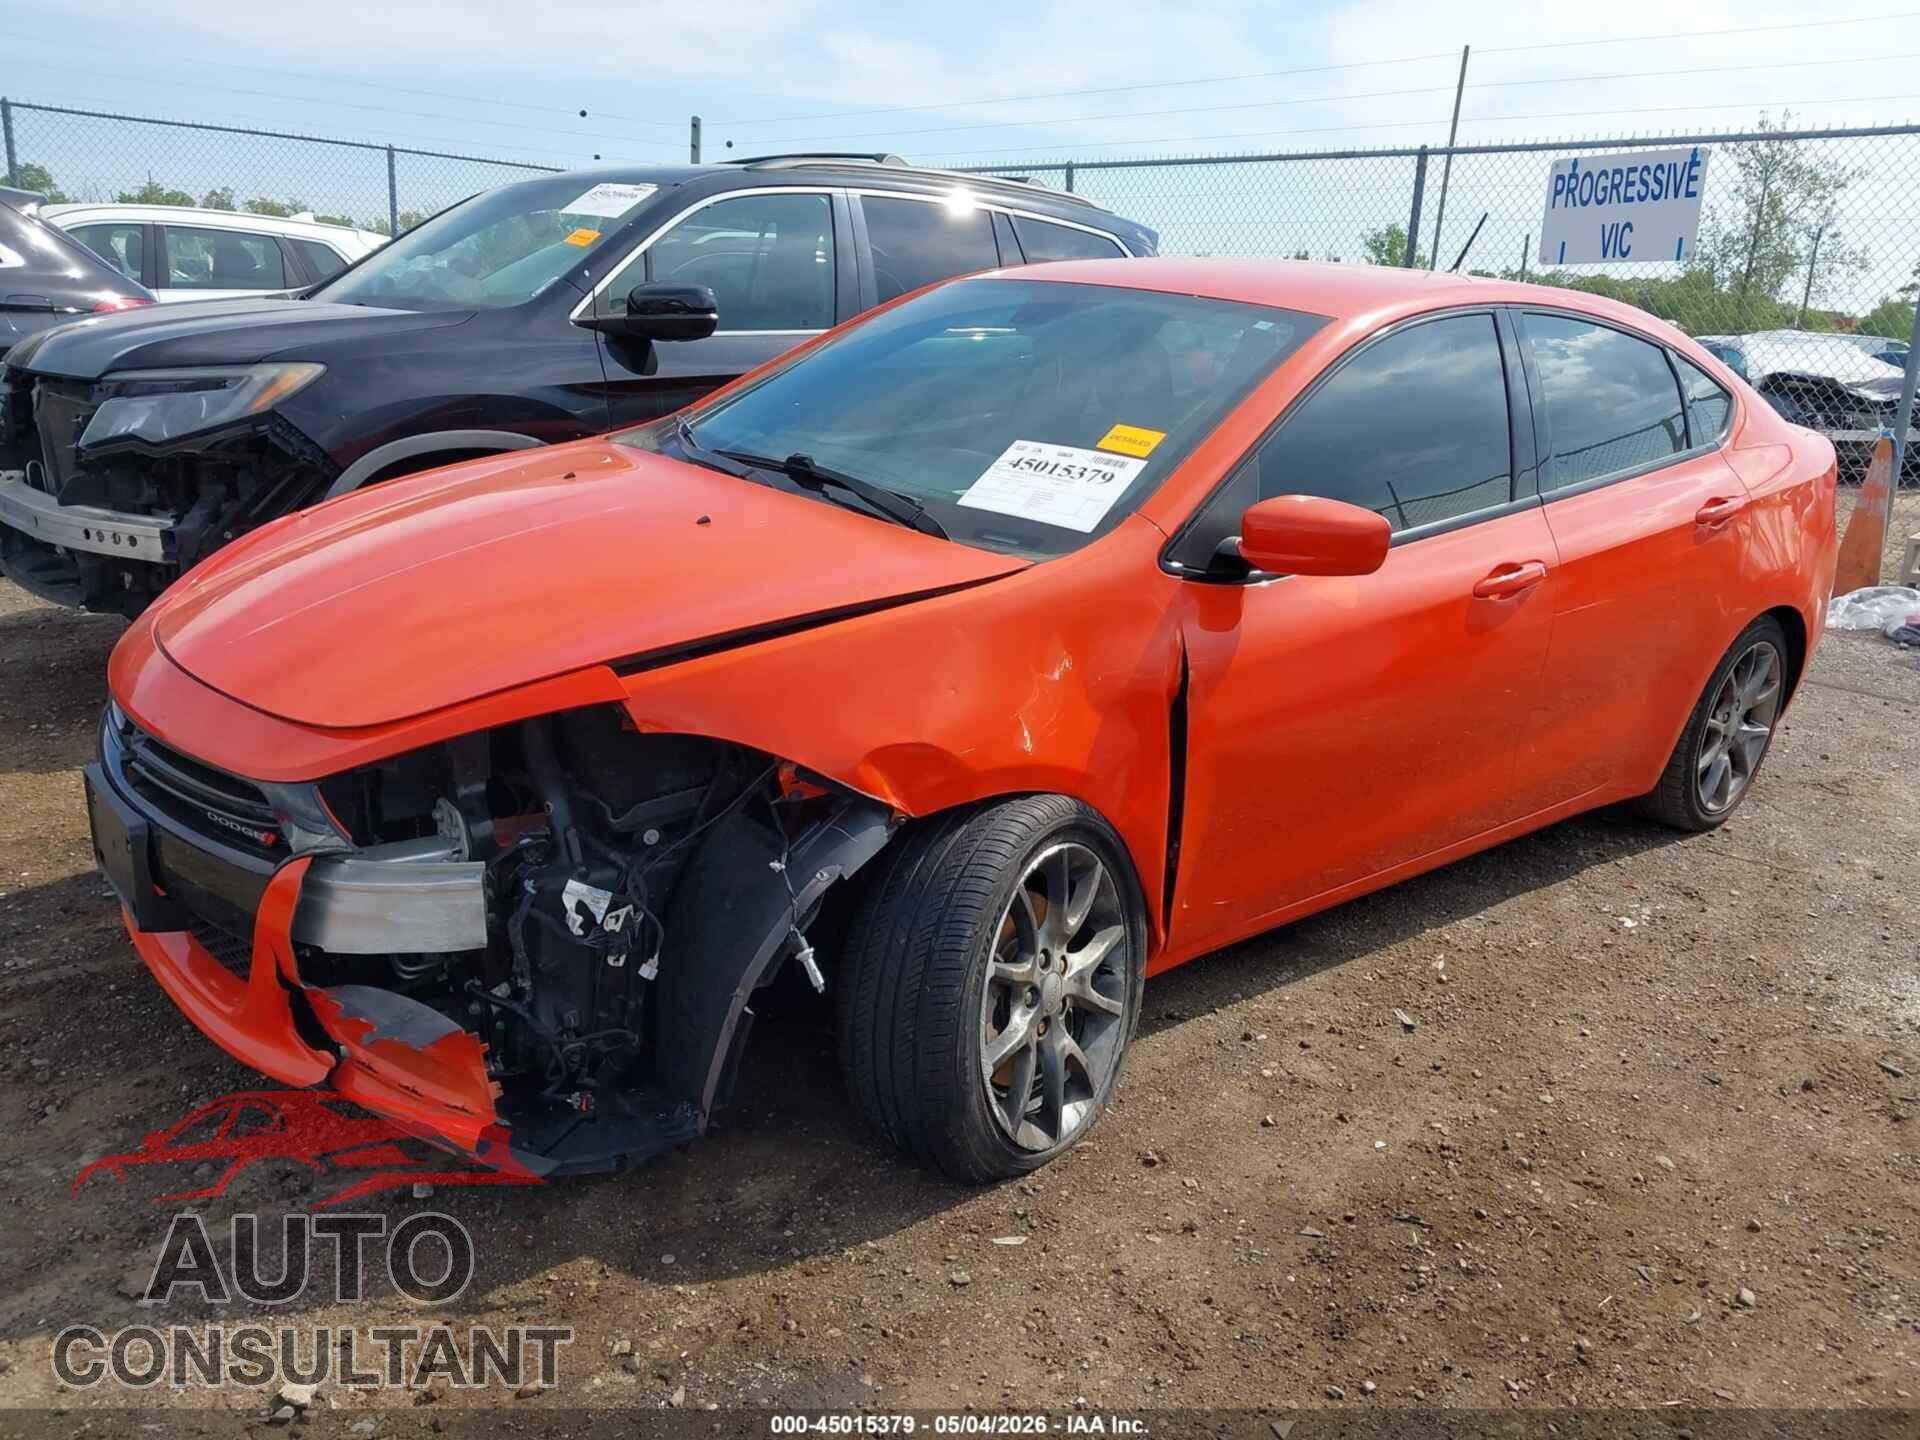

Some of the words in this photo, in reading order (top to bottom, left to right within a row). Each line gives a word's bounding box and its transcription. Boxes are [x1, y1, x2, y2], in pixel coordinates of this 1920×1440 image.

[1552, 160, 1700, 209] PROGRESSIVE
[1601, 222, 1634, 258] VIC
[1008, 457, 1115, 484] 45015379
[207, 811, 265, 841] DODGE
